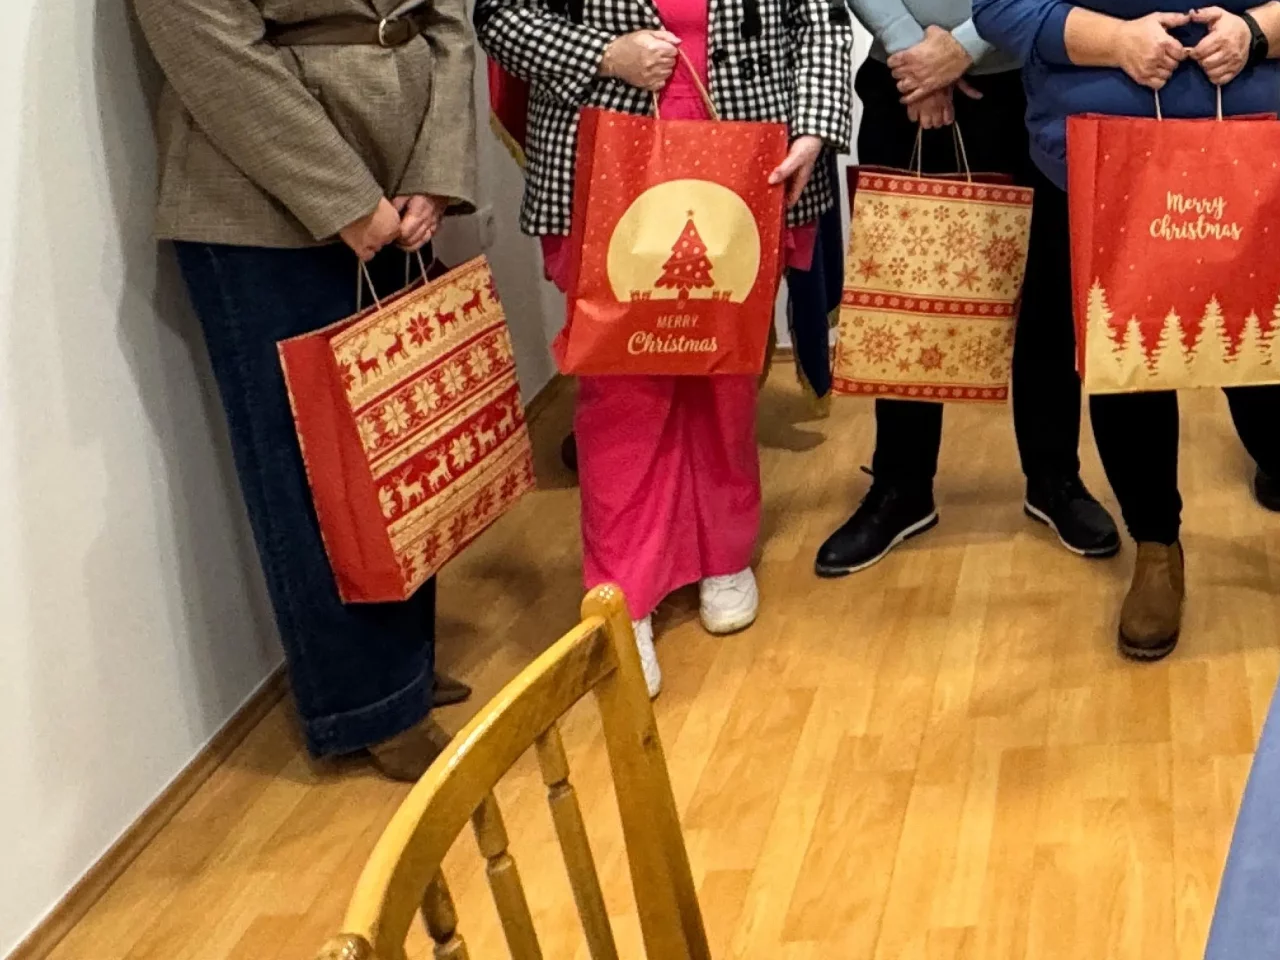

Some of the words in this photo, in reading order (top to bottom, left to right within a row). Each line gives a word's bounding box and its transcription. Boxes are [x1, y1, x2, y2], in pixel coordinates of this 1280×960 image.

[1166, 190, 1227, 221] Merry
[1149, 213, 1244, 241] Christmas
[656, 314, 699, 328] MERRY
[627, 330, 718, 355] Christmas
